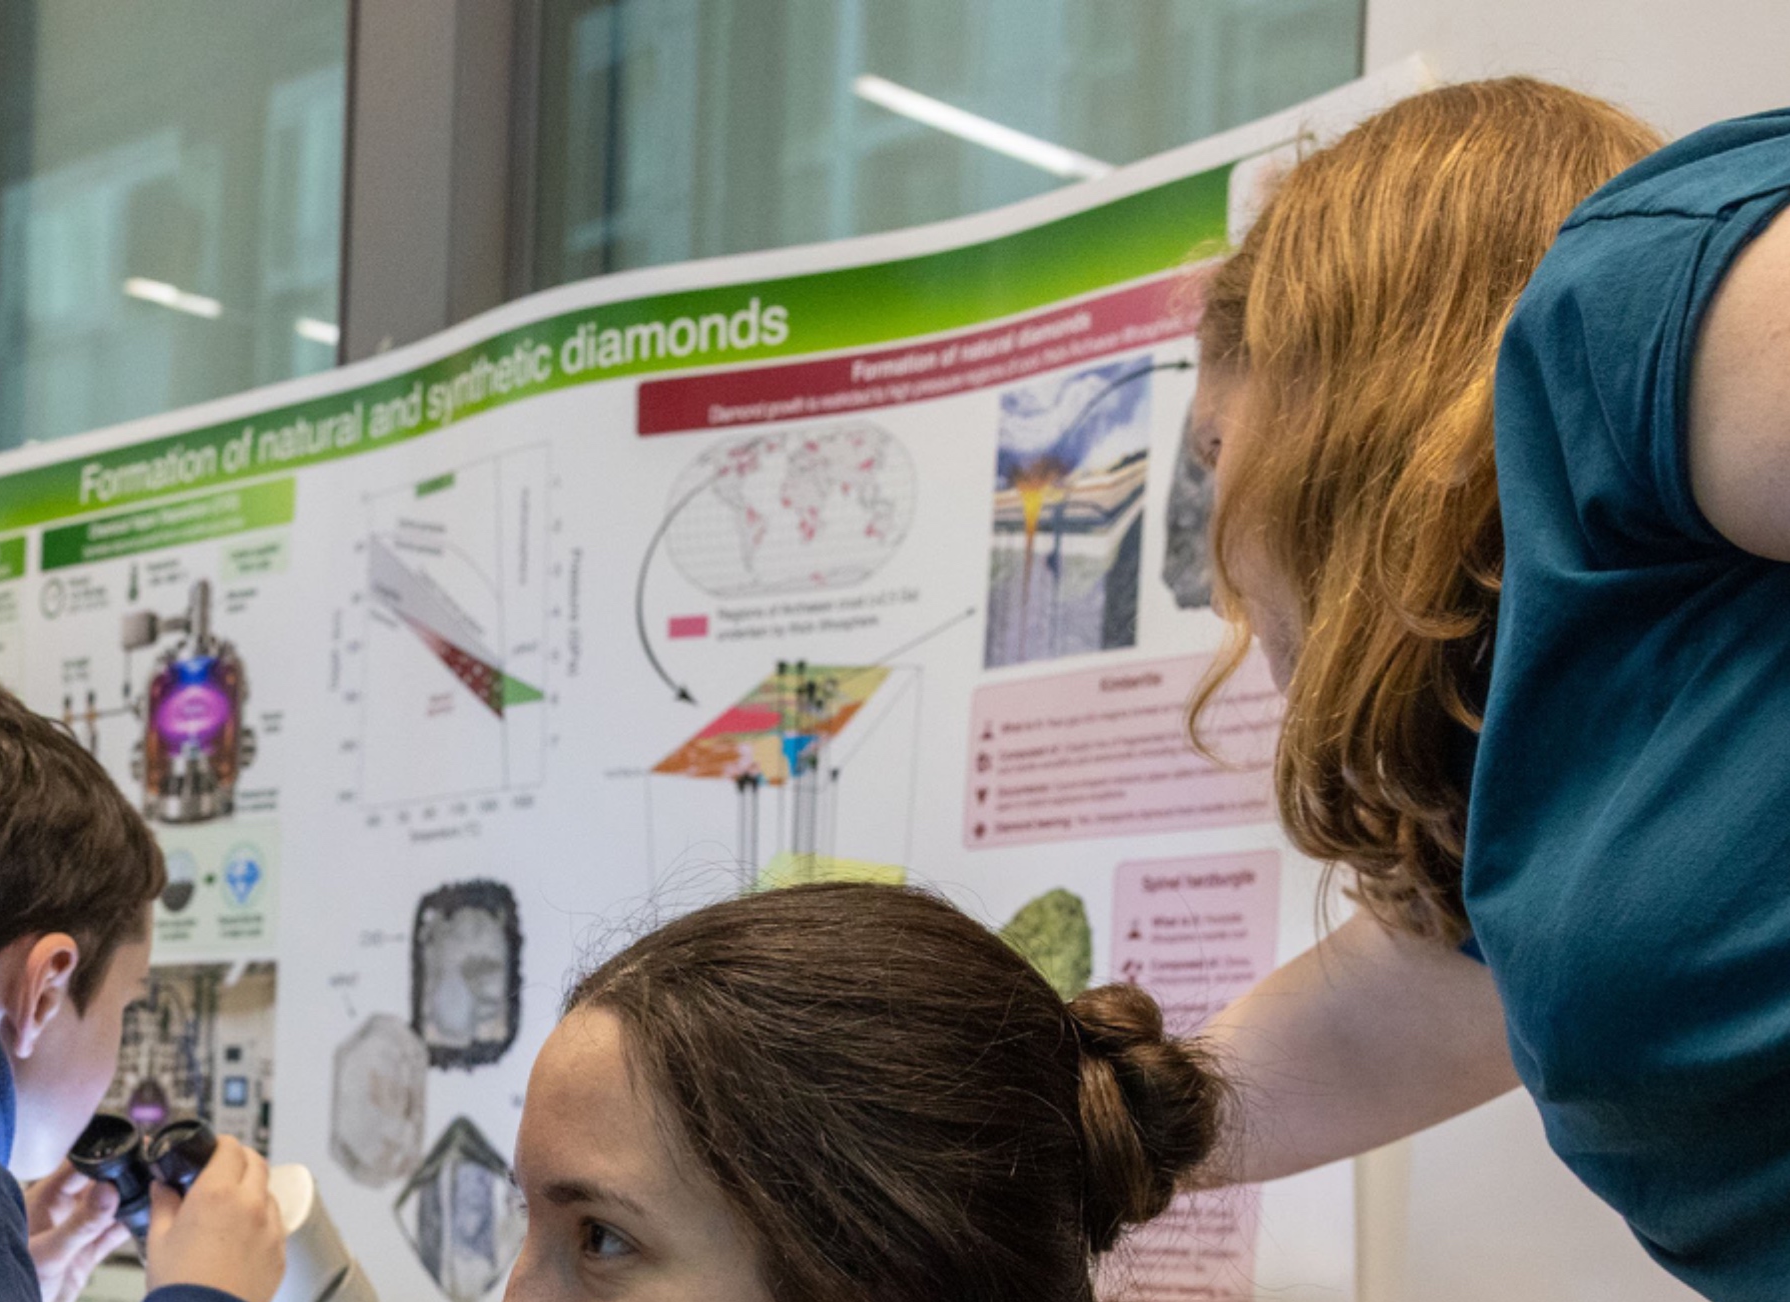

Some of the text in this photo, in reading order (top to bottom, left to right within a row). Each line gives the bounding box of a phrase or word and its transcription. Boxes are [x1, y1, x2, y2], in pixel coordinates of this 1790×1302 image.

[79, 298, 791, 505] Formation of natural and synthetic diamonds
[850, 350, 936, 382] Formation
